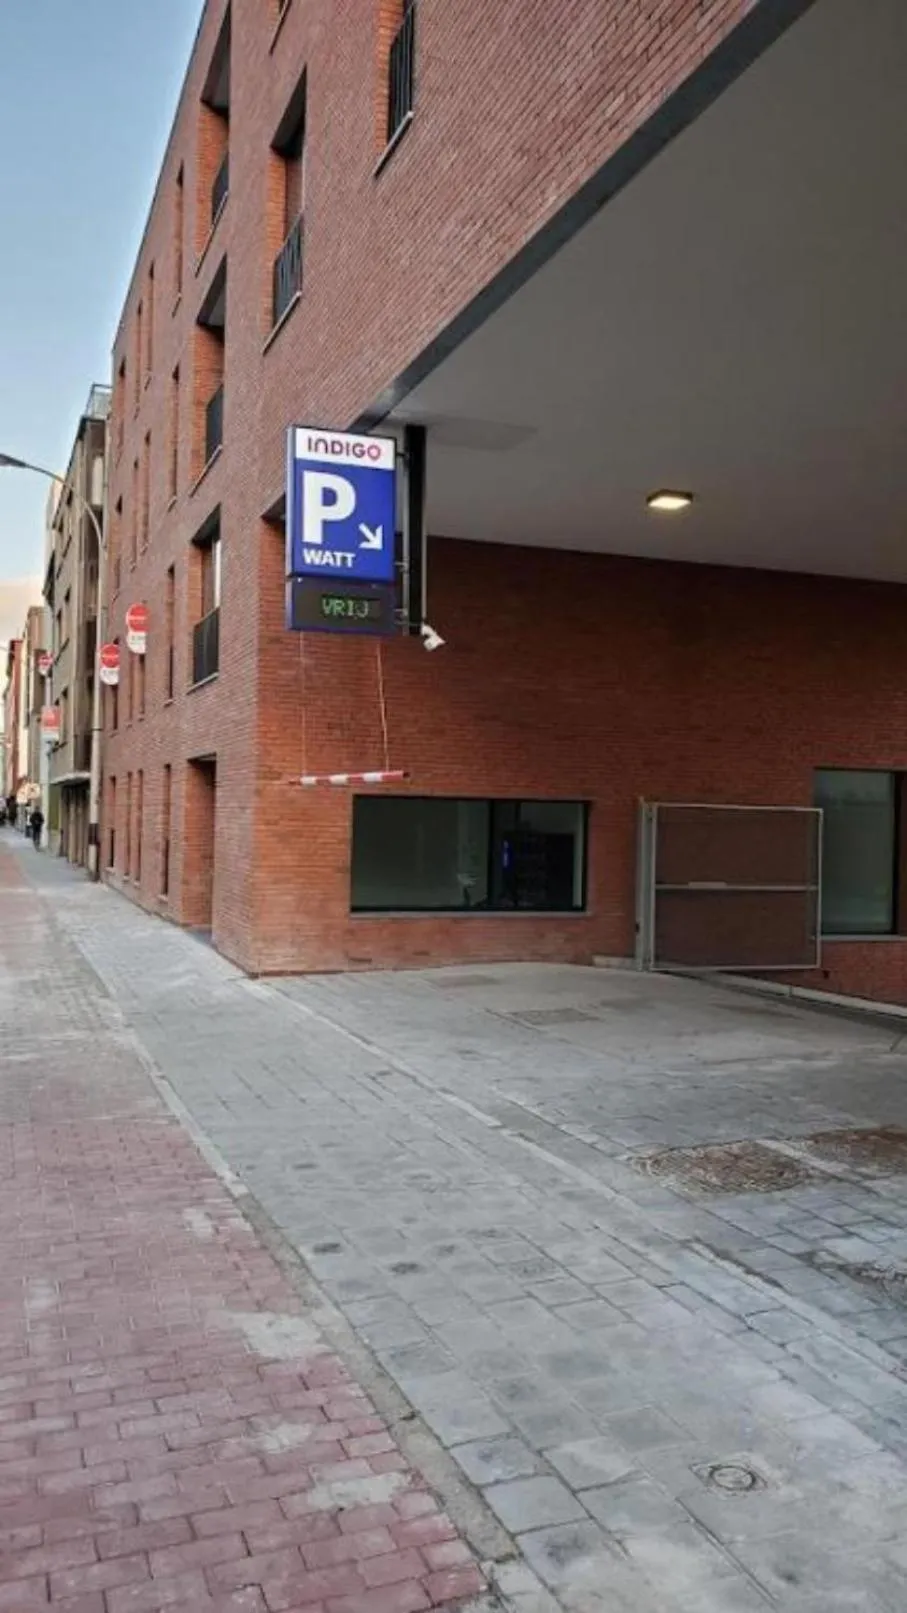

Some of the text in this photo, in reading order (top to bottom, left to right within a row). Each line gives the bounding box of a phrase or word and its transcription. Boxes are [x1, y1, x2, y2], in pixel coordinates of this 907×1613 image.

[302, 470, 356, 544] P
[303, 548, 356, 568] WATT
[321, 598, 369, 618] VRIJ
